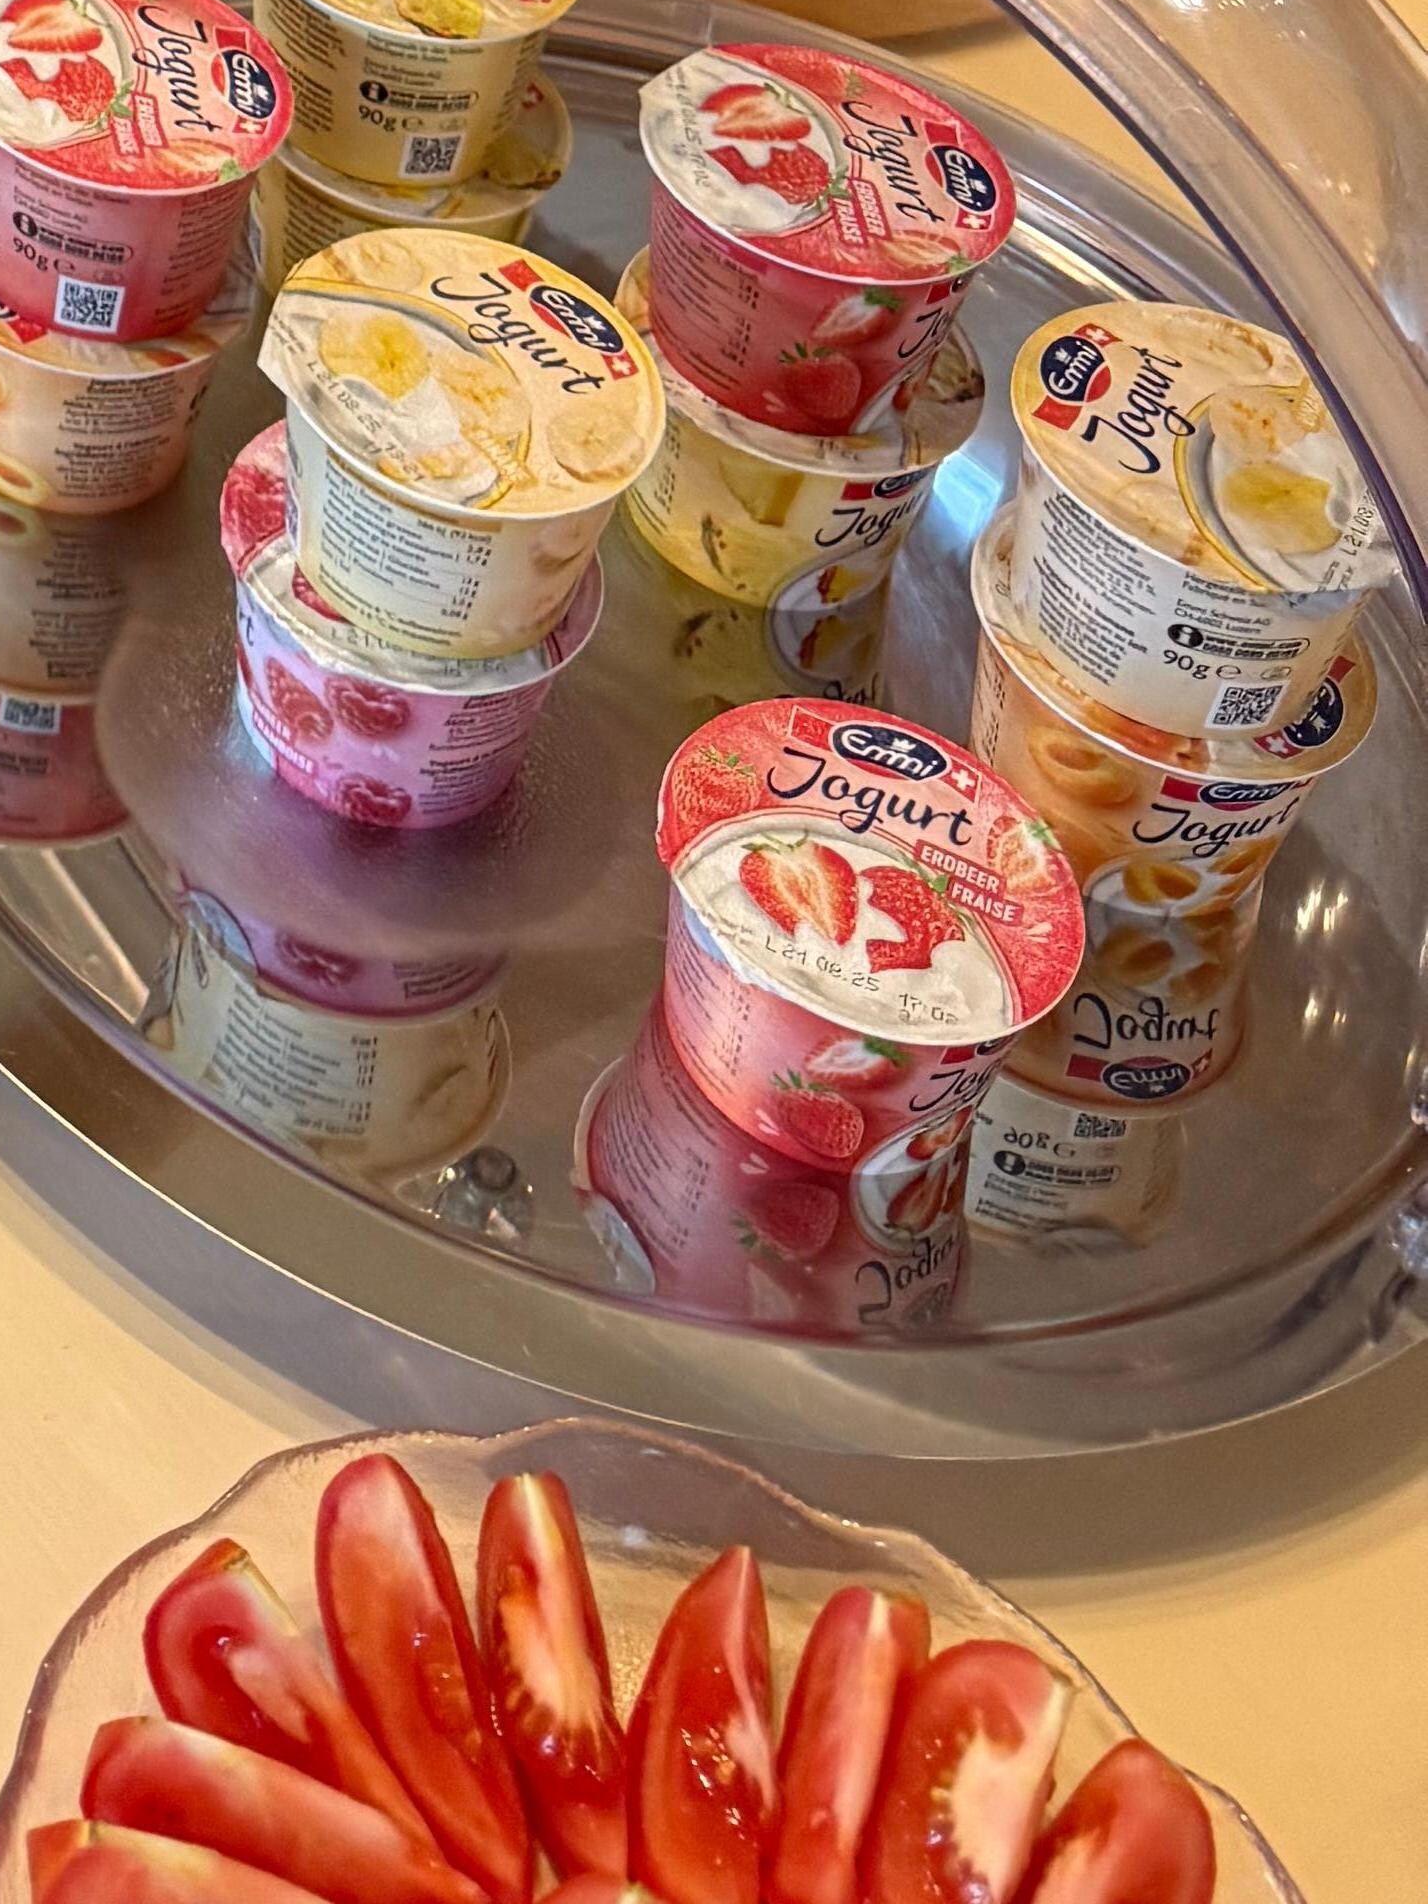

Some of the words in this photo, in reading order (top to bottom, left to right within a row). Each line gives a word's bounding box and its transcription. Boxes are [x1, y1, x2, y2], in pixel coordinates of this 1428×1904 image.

[132, 5, 224, 136] Jogurt
[232, 53, 266, 118] Emmi
[358, 104, 398, 132] 90g
[842, 101, 946, 225] Jogurt
[943, 149, 983, 210] Emmi
[11, 238, 49, 272] 90g
[430, 272, 605, 394] Jogurt
[543, 289, 618, 353] Emmi
[1048, 340, 1099, 395] Emmi
[1080, 345, 1197, 475] Jogurt
[1254, 616, 1271, 627] AG
[1161, 648, 1210, 681] 90g
[841, 727, 939, 778] Emmi
[766, 745, 973, 847] Jogurt
[1132, 795, 1300, 858] Jogurt
[919, 844, 1002, 894] ERDBEER
[950, 881, 1019, 923] FRAISE
